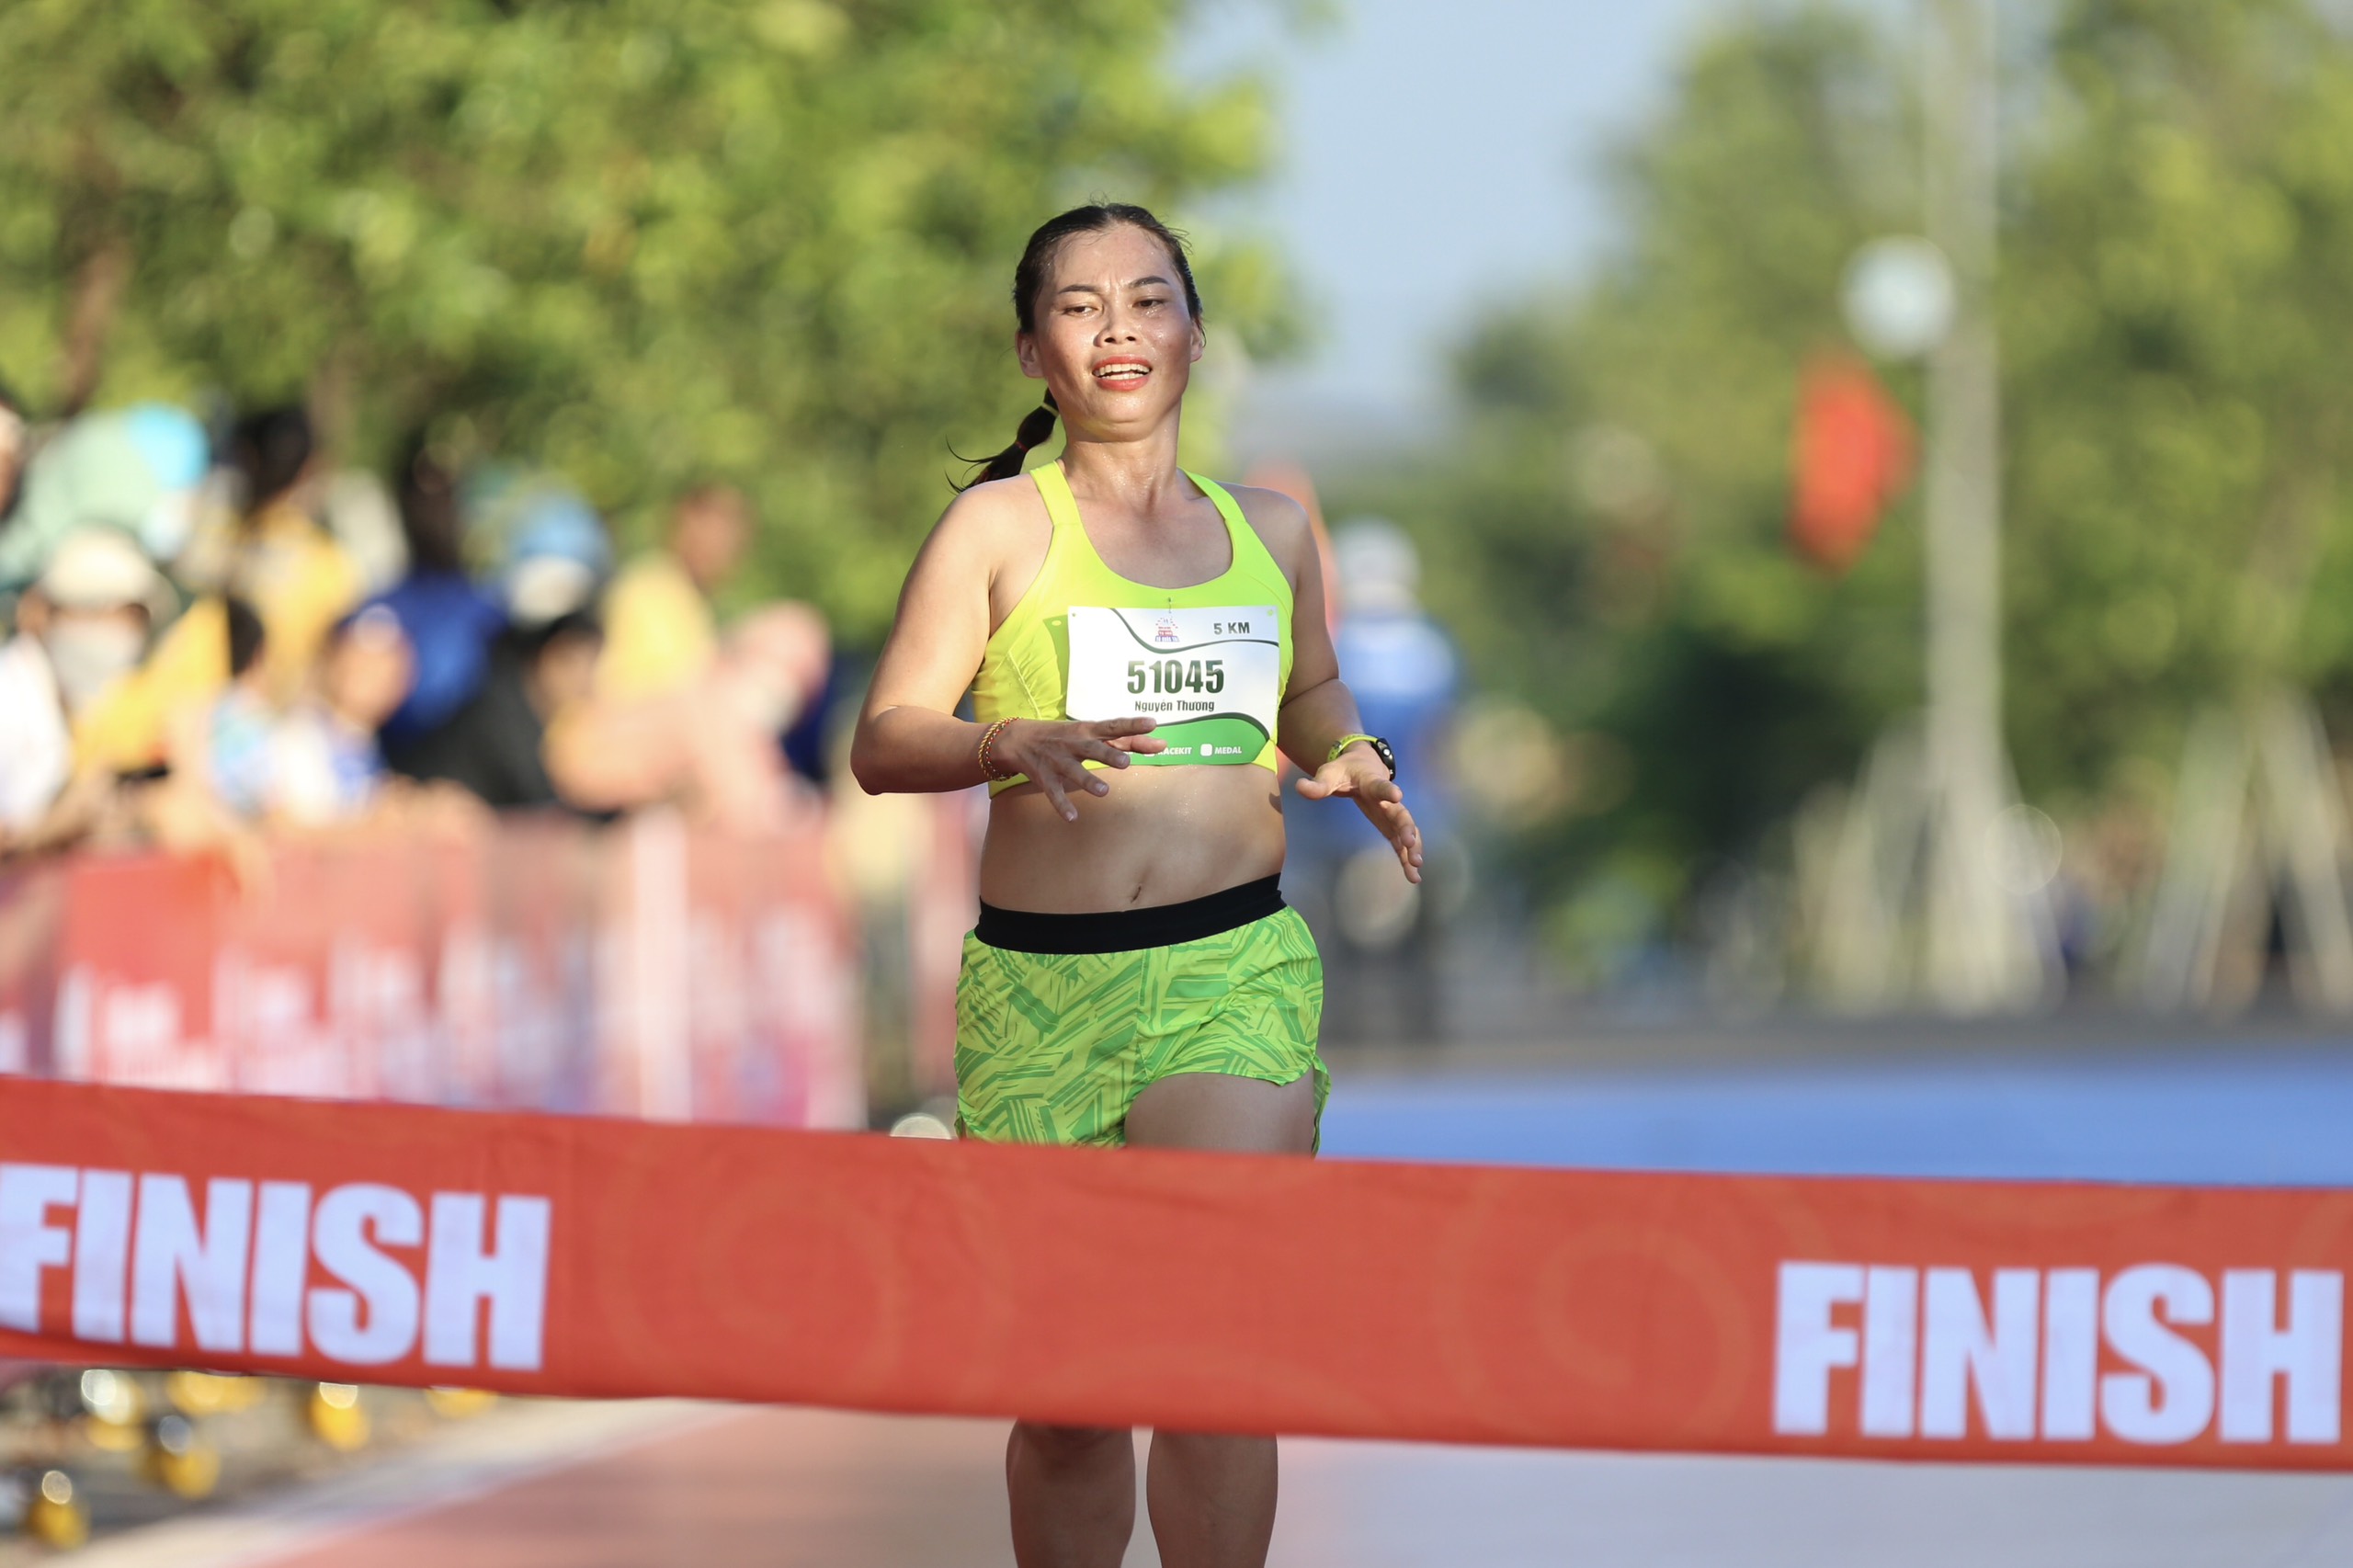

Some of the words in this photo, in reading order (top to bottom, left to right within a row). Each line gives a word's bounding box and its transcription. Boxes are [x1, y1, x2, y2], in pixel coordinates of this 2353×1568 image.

[1213, 622, 1222, 635] 5
[1228, 621, 1250, 634] KM
[1127, 659, 1224, 694] 51045
[1214, 746, 1243, 755] MEDAL
[0, 1162, 551, 1371] FINISH
[1773, 1259, 2344, 1446] FINISH
